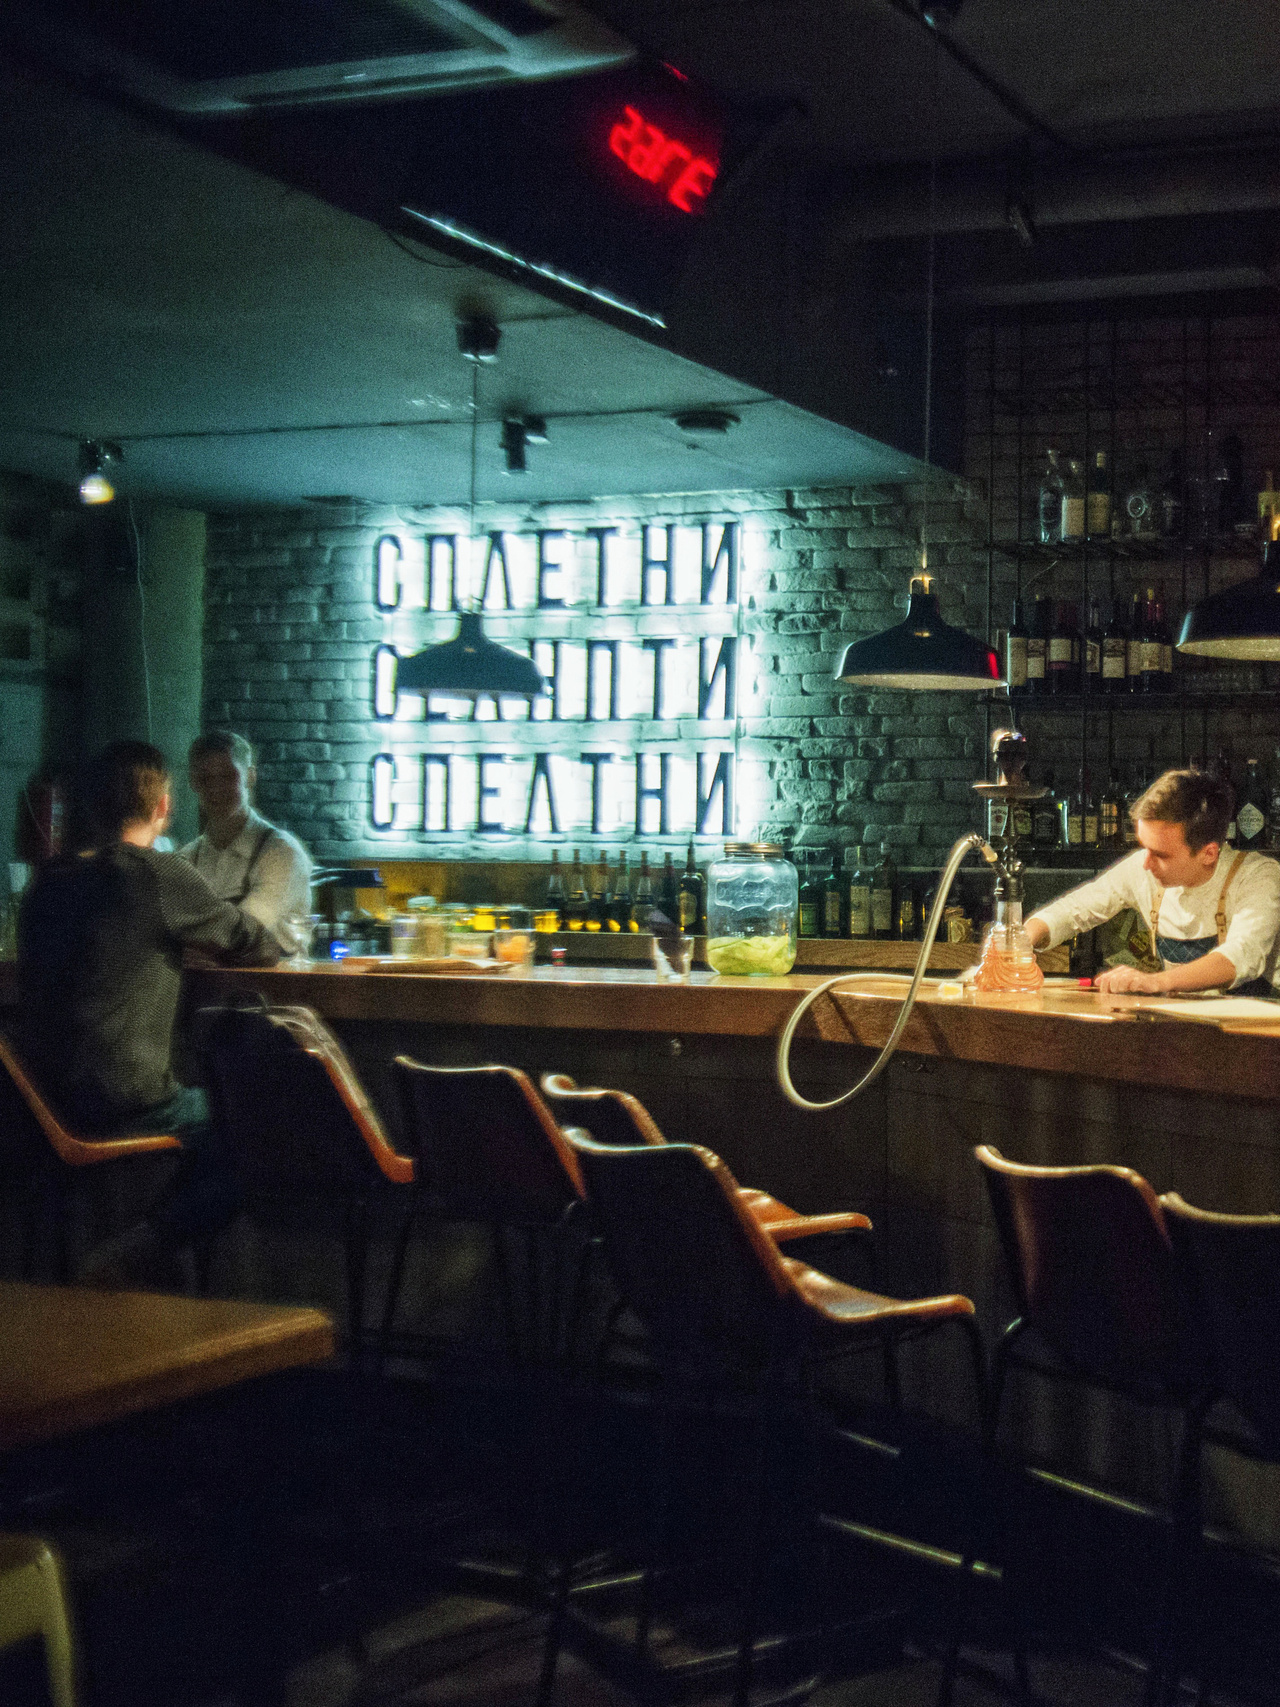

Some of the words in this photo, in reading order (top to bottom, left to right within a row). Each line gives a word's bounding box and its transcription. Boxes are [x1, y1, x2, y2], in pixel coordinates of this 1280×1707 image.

[373, 520, 740, 614] СПЛЕТНИ
[373, 636, 737, 722] СНПТИ
[370, 751, 735, 836] СПЕЛТНИ
